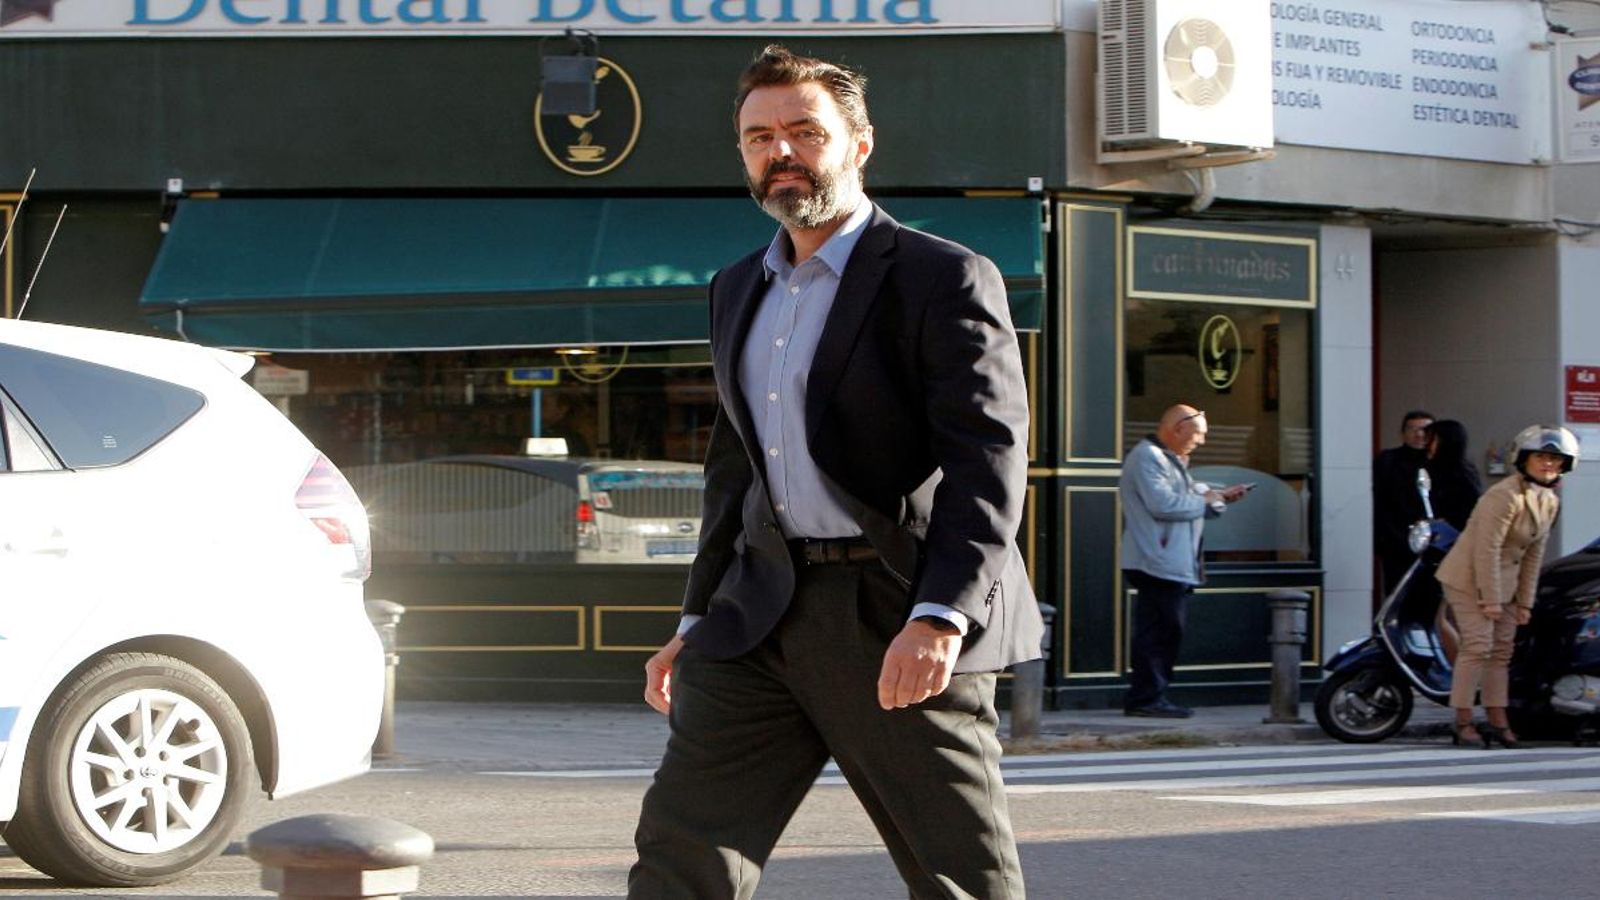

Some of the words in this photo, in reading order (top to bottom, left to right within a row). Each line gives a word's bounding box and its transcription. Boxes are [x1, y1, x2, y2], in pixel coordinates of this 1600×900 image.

[1323, 9, 1384, 31] GENERAL
[1285, 32, 1361, 57] IMPLANTES
[1411, 21, 1495, 44] ORTODONCIA
[1412, 48, 1498, 72] PERIODONCIA
[1286, 61, 1312, 79] FIJA
[1314, 64, 1324, 80] Y
[1326, 66, 1402, 89] REMOVIBLE
[1413, 76, 1498, 99] ENDODONCIA
[1413, 102, 1470, 124] ESTÉTICA
[1472, 109, 1519, 129] DENTAL
